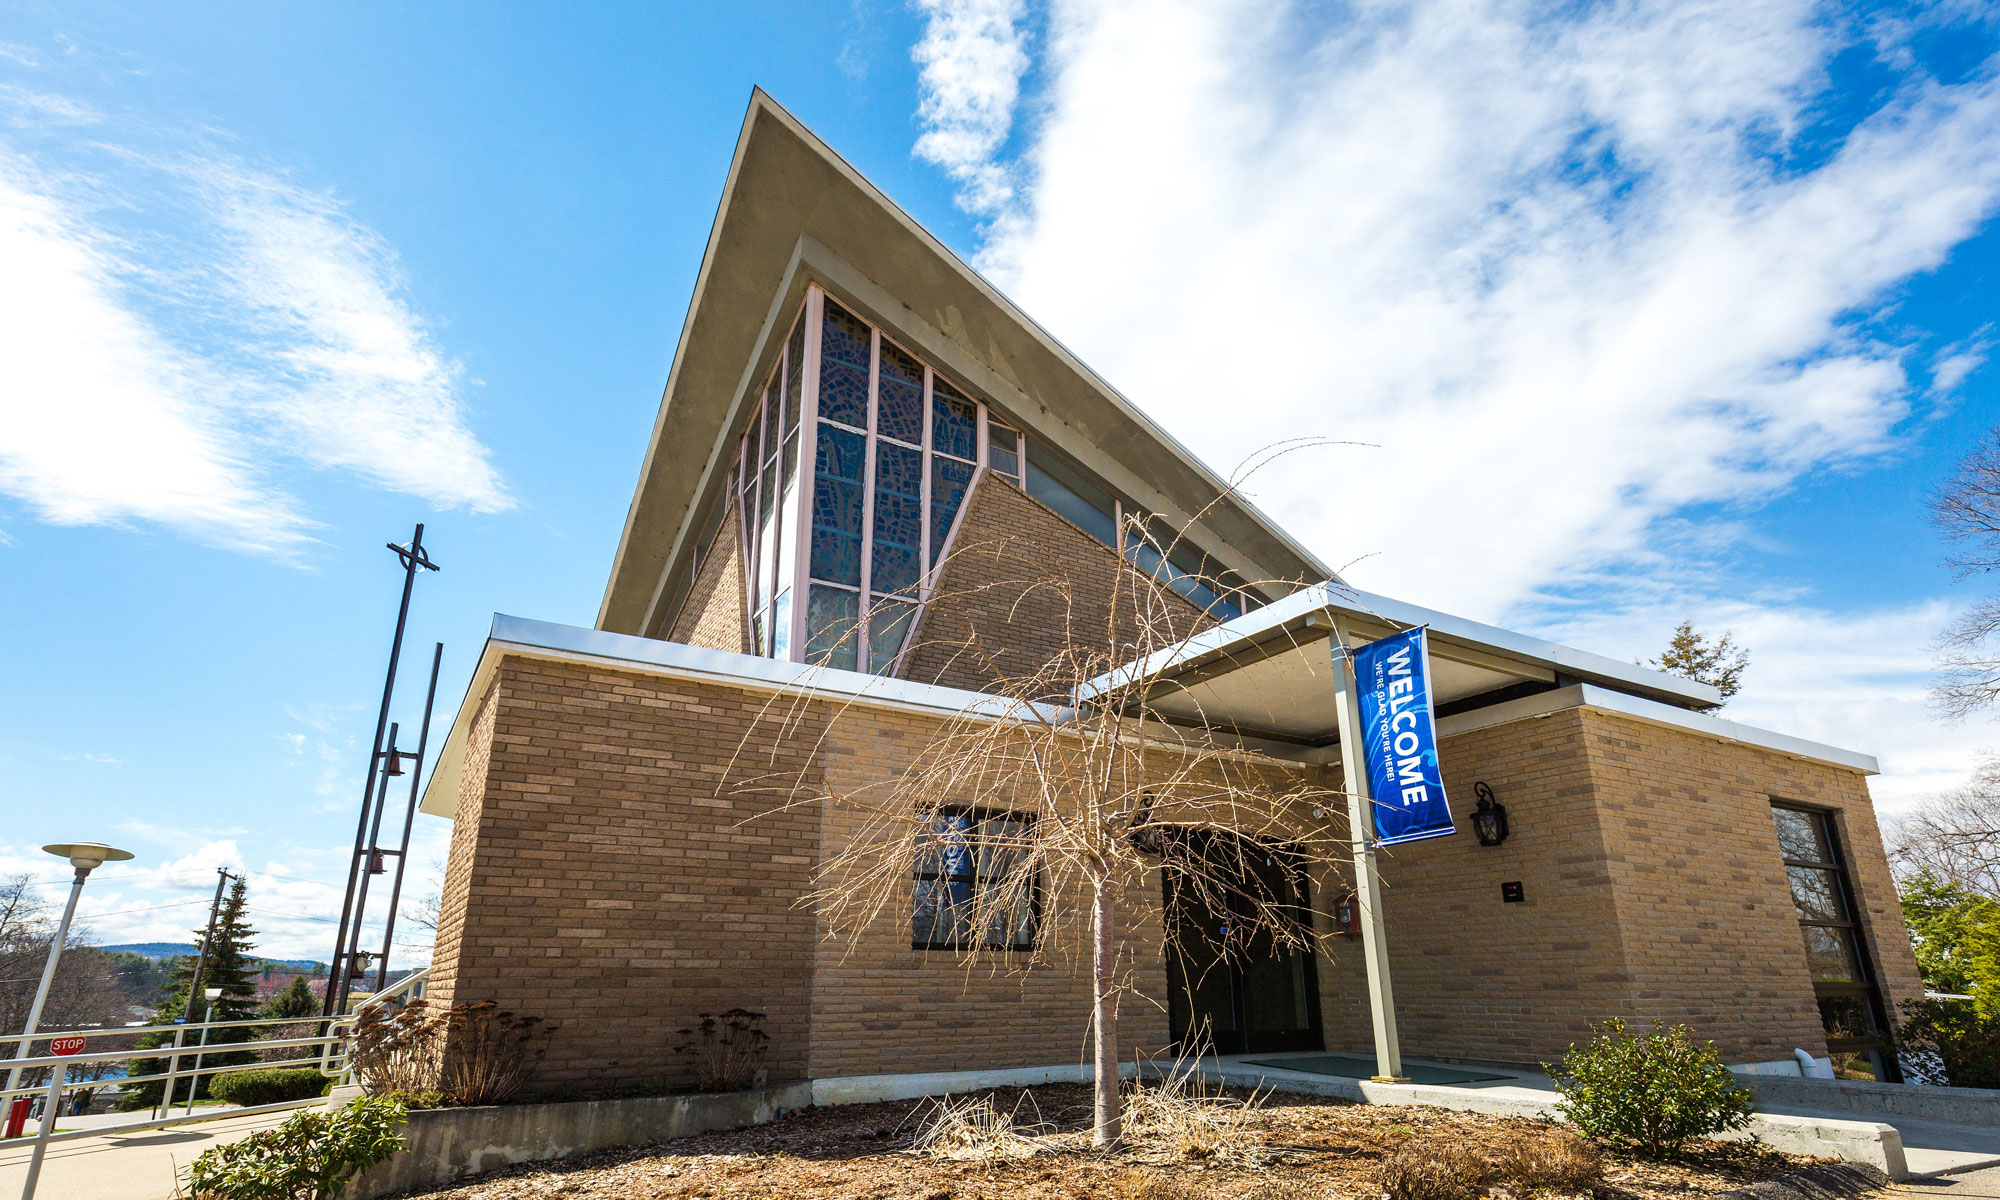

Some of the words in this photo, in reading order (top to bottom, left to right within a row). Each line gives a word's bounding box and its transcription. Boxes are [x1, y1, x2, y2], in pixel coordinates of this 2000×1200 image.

[1375, 661, 1385, 690] WE'RE
[1377, 691, 1387, 716] GLAD
[1380, 717, 1391, 752] YOU'RE
[1387, 645, 1428, 806] WELCOME
[1384, 754, 1395, 782] HERE!
[53, 1038, 84, 1051] STOP
